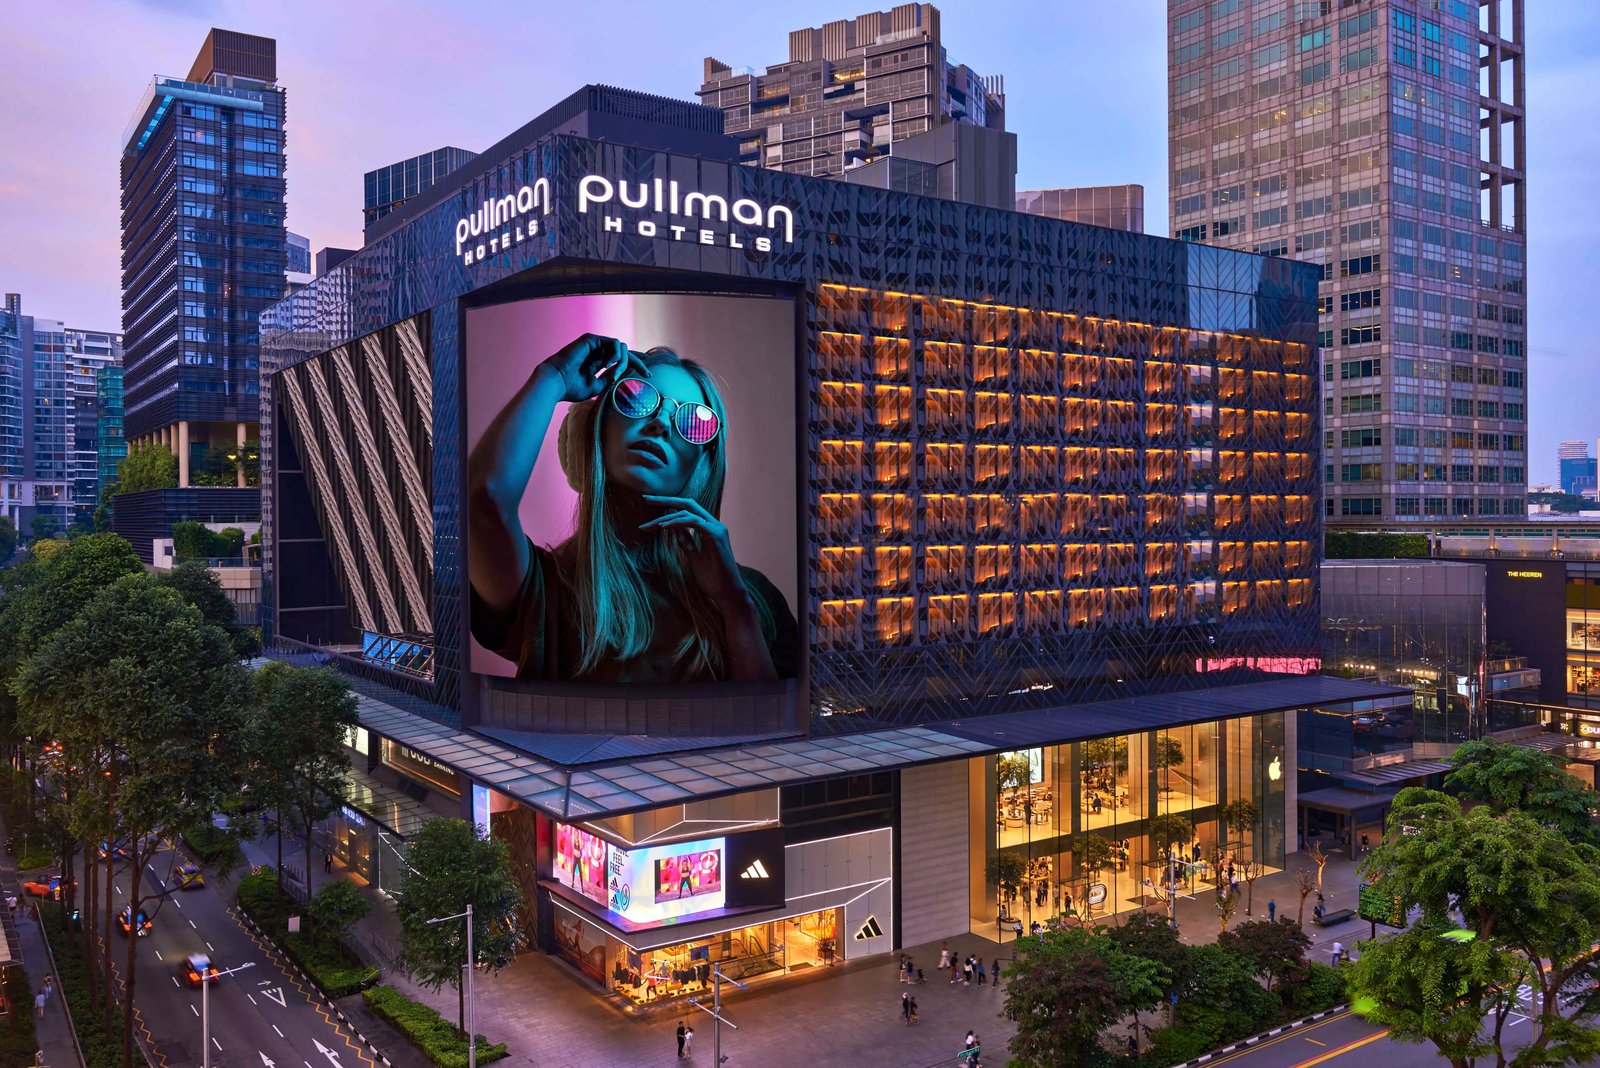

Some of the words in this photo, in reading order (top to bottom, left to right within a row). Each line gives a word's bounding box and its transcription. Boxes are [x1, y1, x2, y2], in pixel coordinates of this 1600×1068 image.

[456, 177, 550, 256] pullman
[579, 175, 793, 243] pullman
[604, 215, 771, 252] HOTELS
[465, 219, 539, 266] HOTELS
